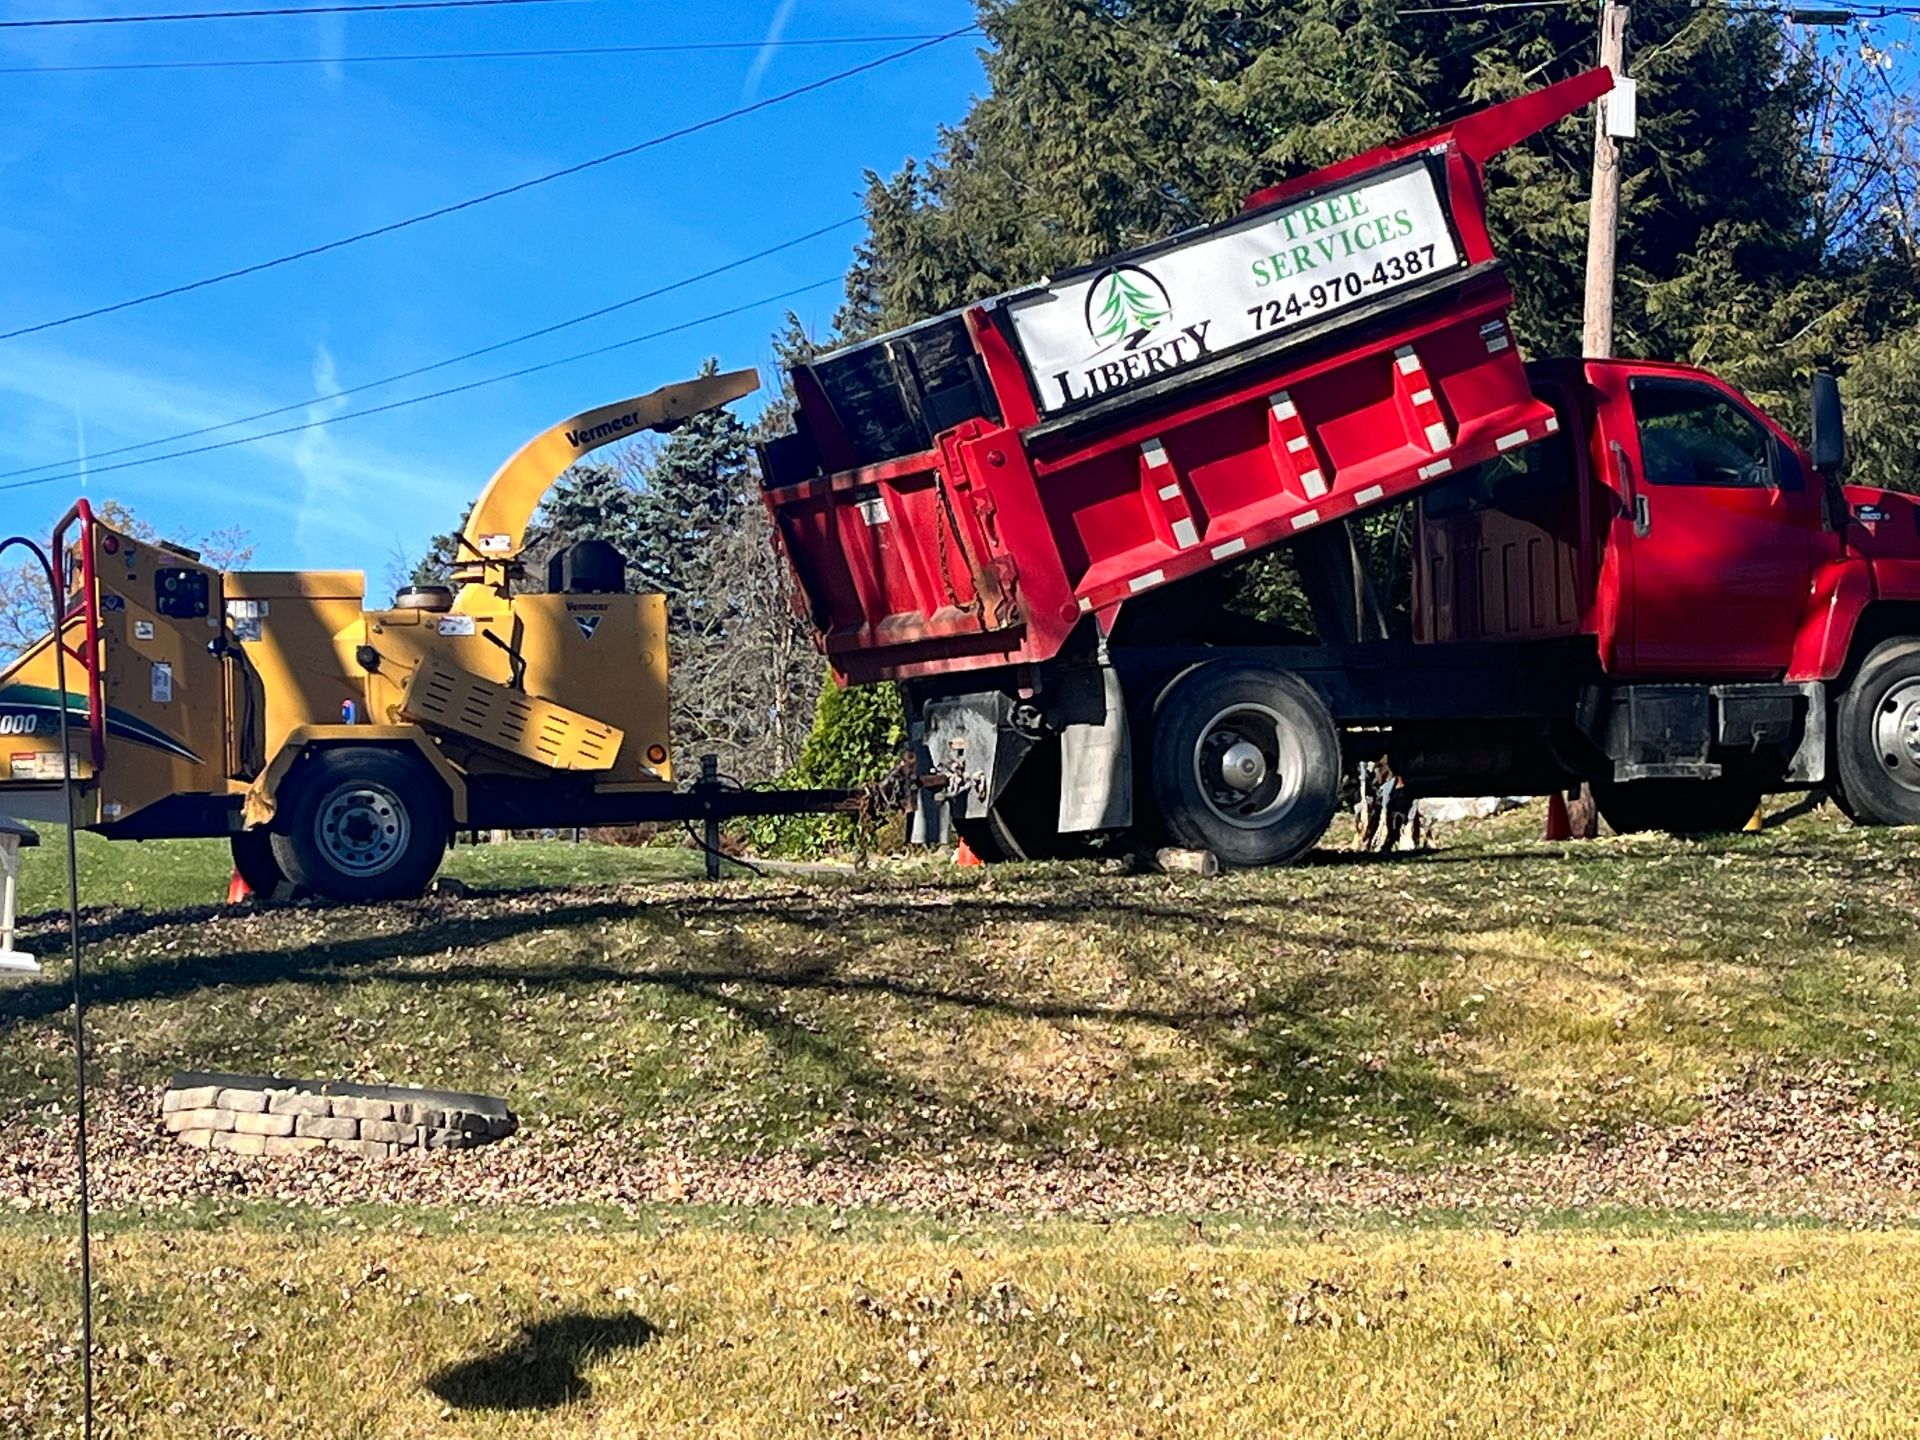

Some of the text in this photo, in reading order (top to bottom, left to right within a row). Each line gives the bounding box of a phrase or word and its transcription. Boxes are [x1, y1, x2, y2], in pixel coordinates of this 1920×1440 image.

[1251, 208, 1414, 288] SERVICES
[1276, 188, 1370, 242] TREE
[1246, 242, 1436, 331] 724-970-4387
[1052, 319, 1213, 407] LIBERTY
[565, 411, 639, 447] Vermeer
[0, 713, 37, 734] 000
